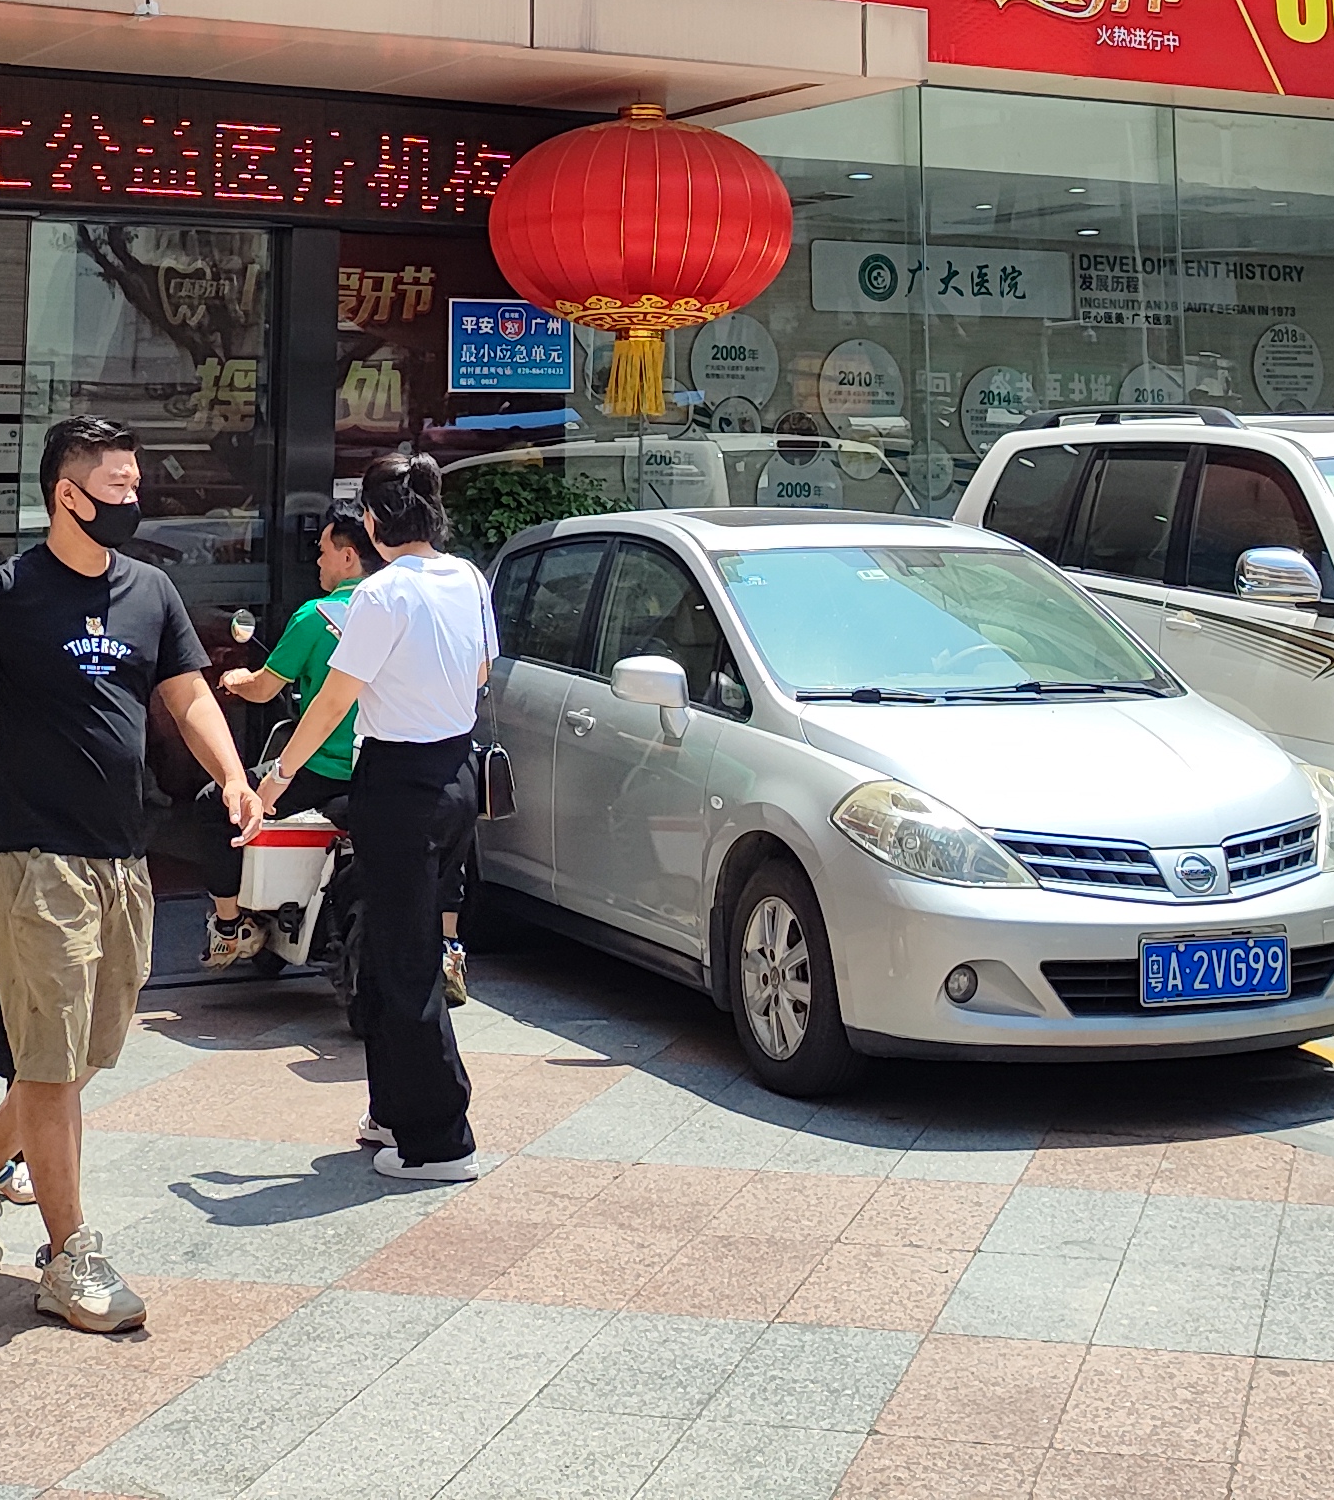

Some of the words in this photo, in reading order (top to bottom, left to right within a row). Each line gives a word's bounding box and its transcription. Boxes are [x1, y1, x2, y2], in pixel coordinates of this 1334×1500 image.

[1095, 26, 1181, 52] 火热进行中
[905, 258, 1027, 301] 广大医院
[1225, 261, 1305, 283] HISTORY
[1079, 274, 1140, 294] 发展历程
[1079, 296, 1143, 312] INGENUITY
[1271, 305, 1296, 317] 1973
[461, 316, 495, 335] 平安
[530, 317, 563, 336] 广州
[460, 343, 563, 363] 最小应急单元
